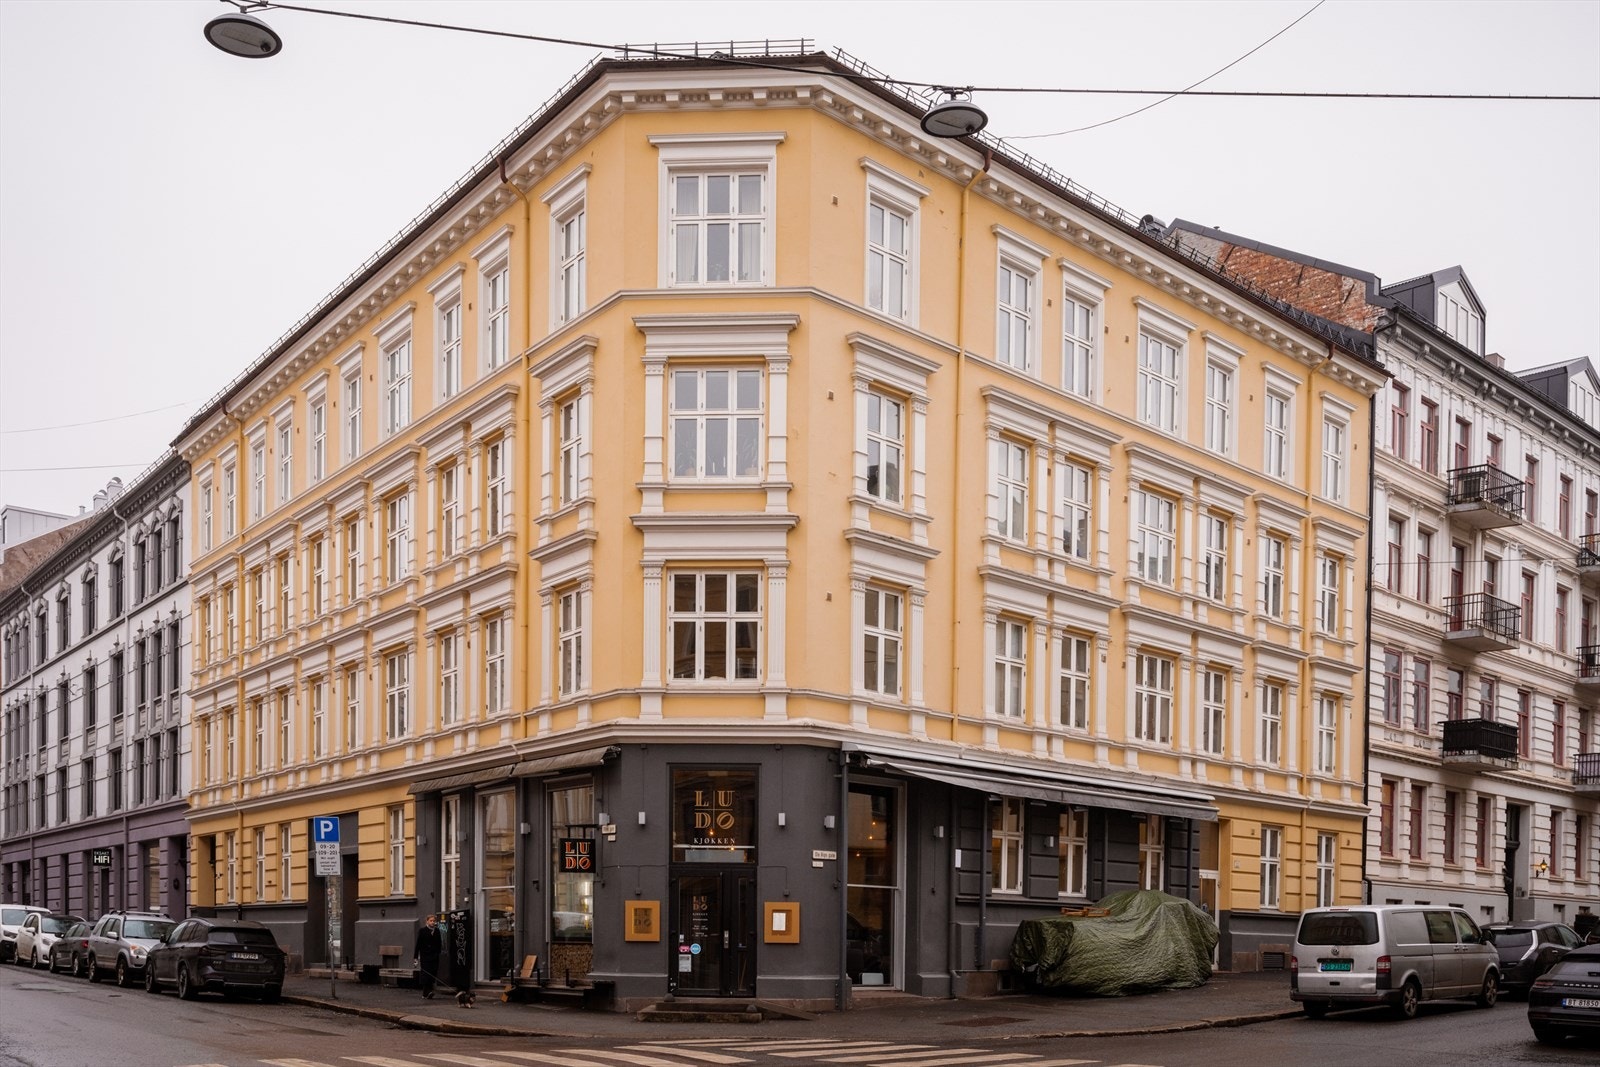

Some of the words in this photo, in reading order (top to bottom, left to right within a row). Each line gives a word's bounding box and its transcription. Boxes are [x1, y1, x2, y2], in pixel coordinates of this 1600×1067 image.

[820, 820, 834, 840] P
[693, 837, 736, 845] KJØKKEN
[94, 856, 110, 864] HIFI
